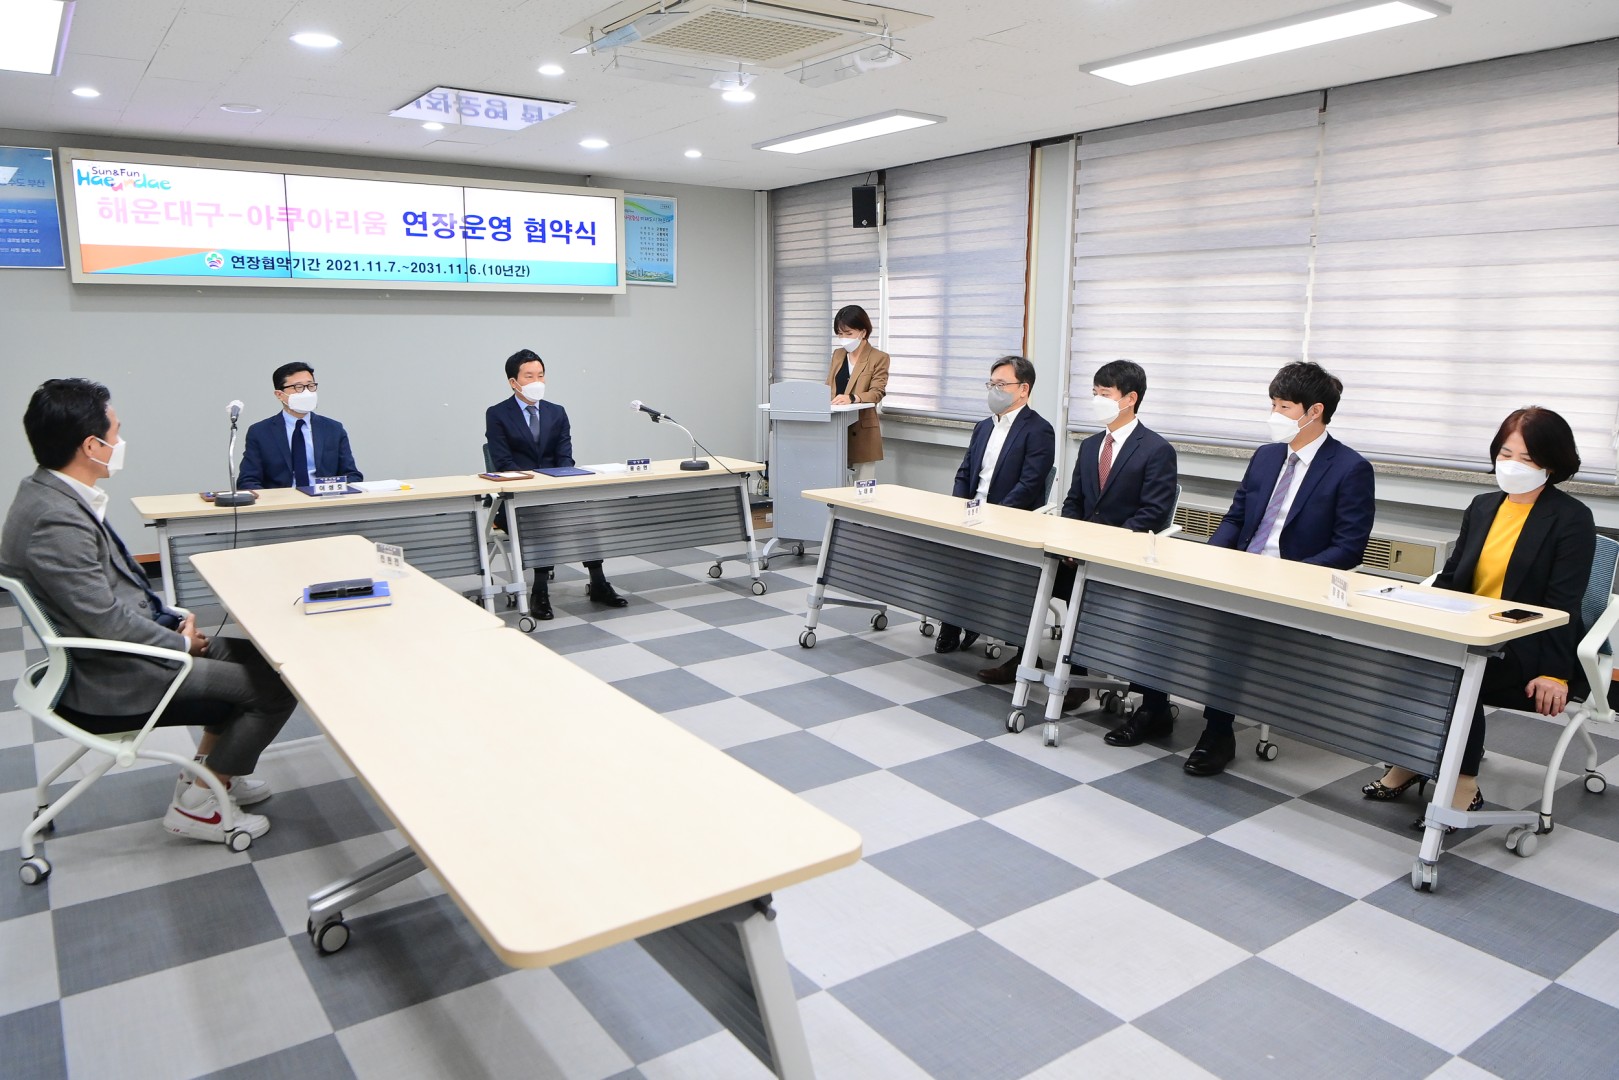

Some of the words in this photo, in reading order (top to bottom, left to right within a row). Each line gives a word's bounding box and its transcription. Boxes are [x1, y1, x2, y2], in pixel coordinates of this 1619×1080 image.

[91, 166, 141, 178] Sun&Fun
[97, 196, 388, 237] 해운대구-아쿠아리움
[402, 210, 512, 242] 연장운영
[524, 217, 597, 246] 협약식
[231, 255, 320, 272] 연장협약기간
[326, 258, 530, 278] 2021.11.7.~2031.11.6.(10년간)
